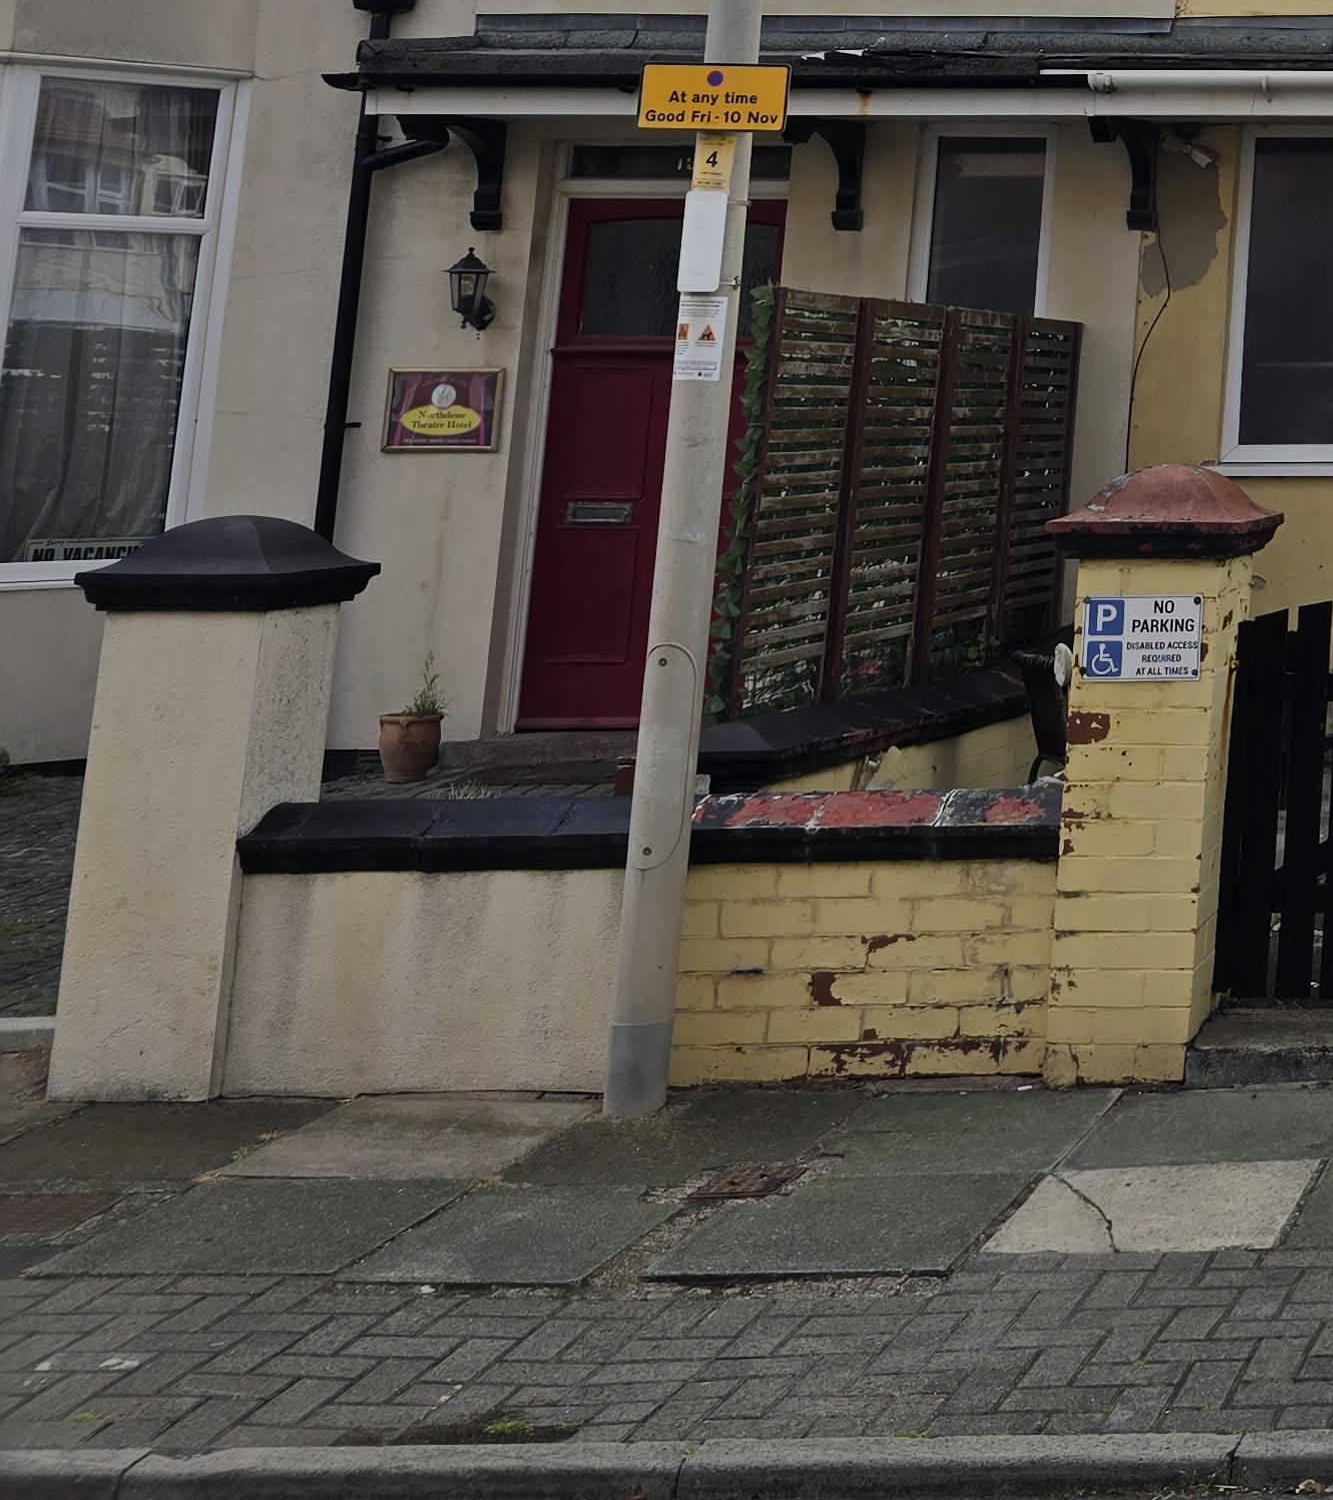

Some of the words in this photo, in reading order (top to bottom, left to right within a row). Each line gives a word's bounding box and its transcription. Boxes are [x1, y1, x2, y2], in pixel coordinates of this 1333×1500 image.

[668, 91, 687, 103] At
[692, 93, 718, 106] any
[725, 91, 758, 104] time
[645, 110, 685, 123] Good
[691, 110, 711, 123] Fri
[723, 111, 740, 124] 10
[748, 111, 778, 124] Nov
[706, 150, 718, 167] 4
[411, 421, 445, 429] Theatre
[447, 421, 472, 429] Hotel
[32, 548, 55, 561] NO
[1153, 600, 1175, 614] NO
[1096, 604, 1117, 631] P
[1132, 619, 1195, 632] PARKING
[1126, 642, 1165, 650] DISABLED
[1167, 641, 1198, 649] ACCESS
[1141, 654, 1182, 663] REQUIRED
[1136, 667, 1146, 675] AT
[1147, 667, 1162, 675] ALL
[1165, 666, 1189, 675] TIMES
